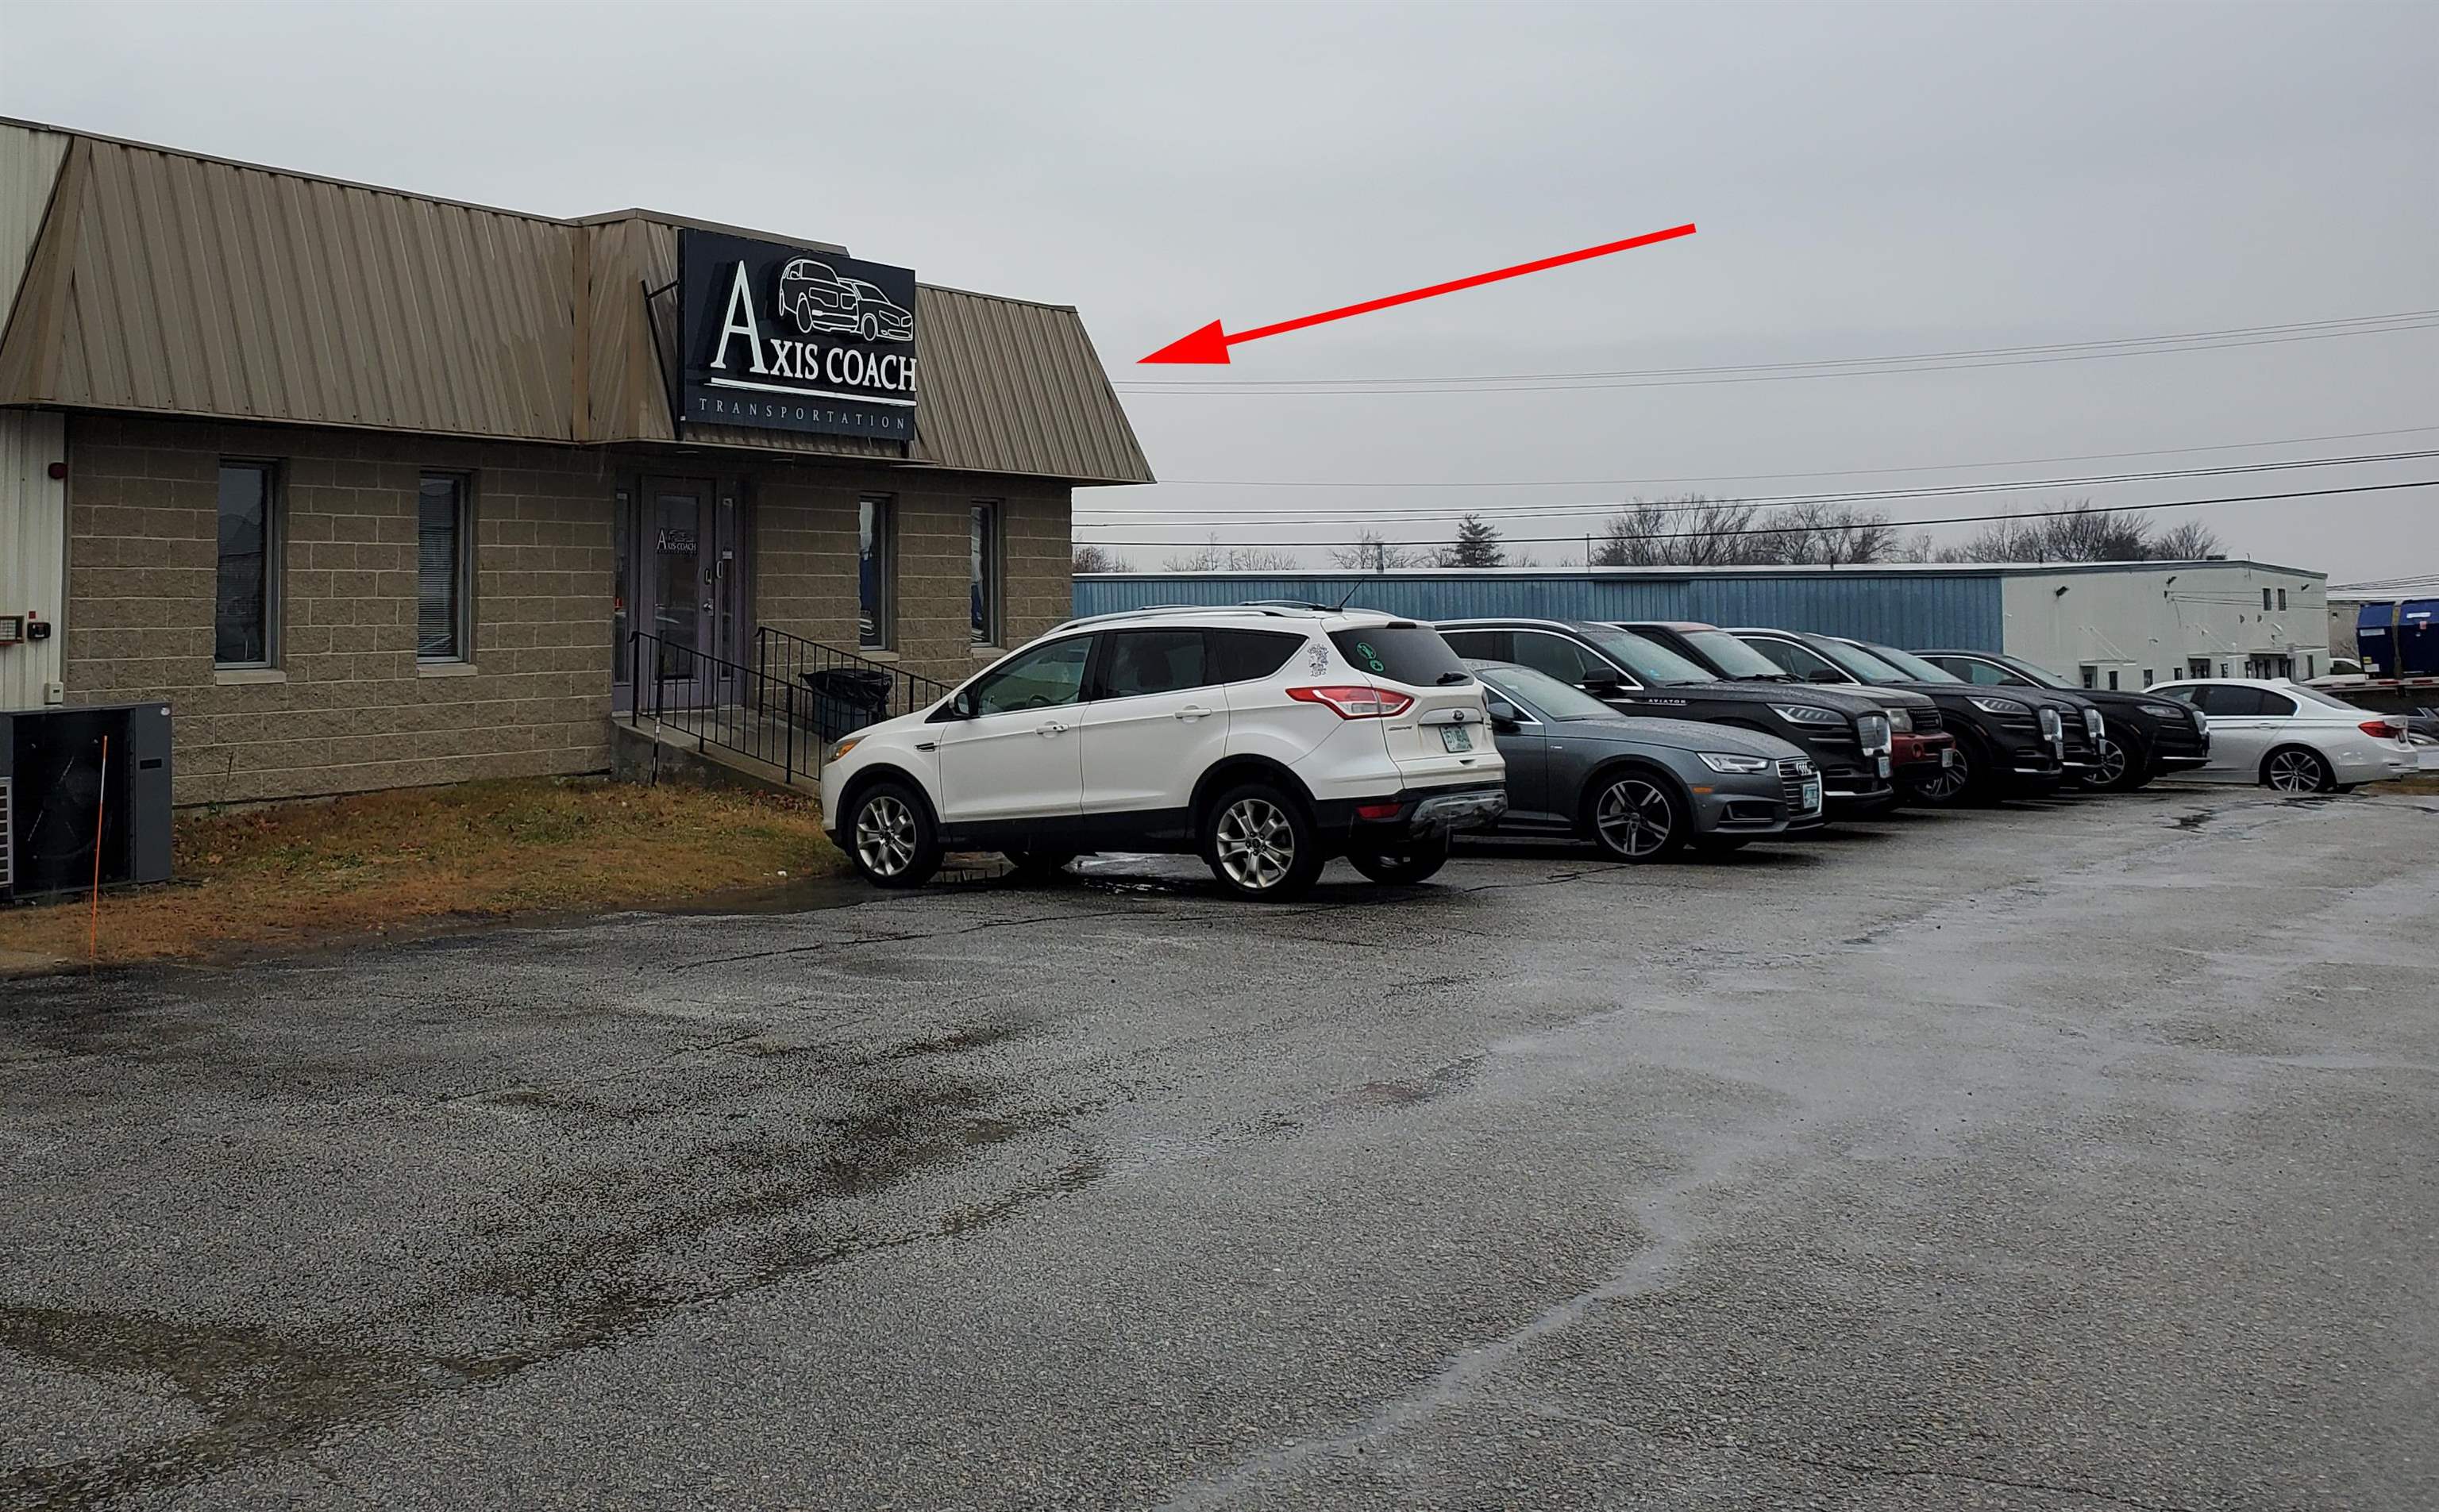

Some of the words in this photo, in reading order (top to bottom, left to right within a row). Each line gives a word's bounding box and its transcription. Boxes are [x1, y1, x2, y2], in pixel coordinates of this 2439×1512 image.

[710, 260, 819, 380] AXIS
[826, 346, 917, 392] COACH
[699, 398, 904, 429] TRANSPORTATION
